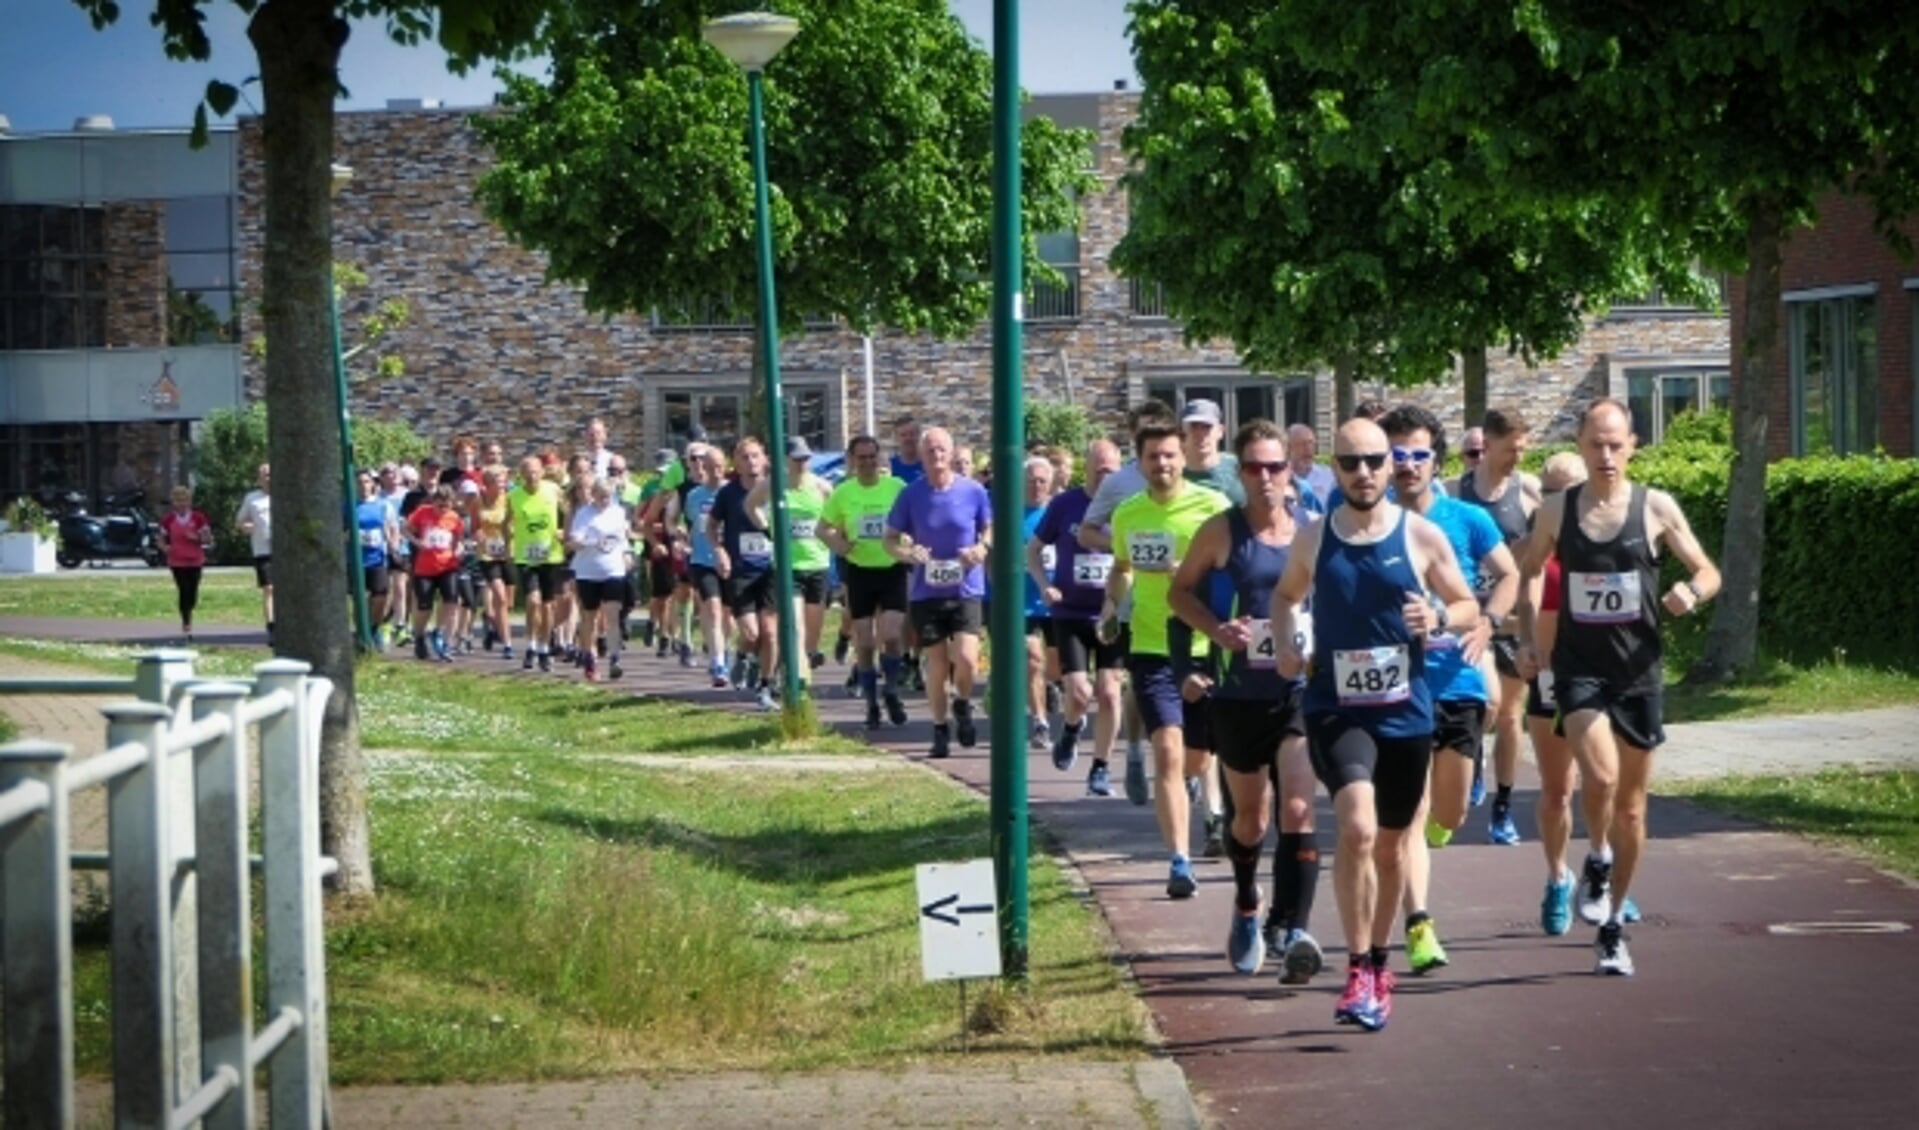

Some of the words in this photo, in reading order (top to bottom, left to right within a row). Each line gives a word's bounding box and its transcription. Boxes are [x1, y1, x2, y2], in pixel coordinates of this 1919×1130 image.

[1132, 544, 1169, 561] 232
[1586, 591, 1622, 611] 70
[1346, 665, 1400, 692] 482
